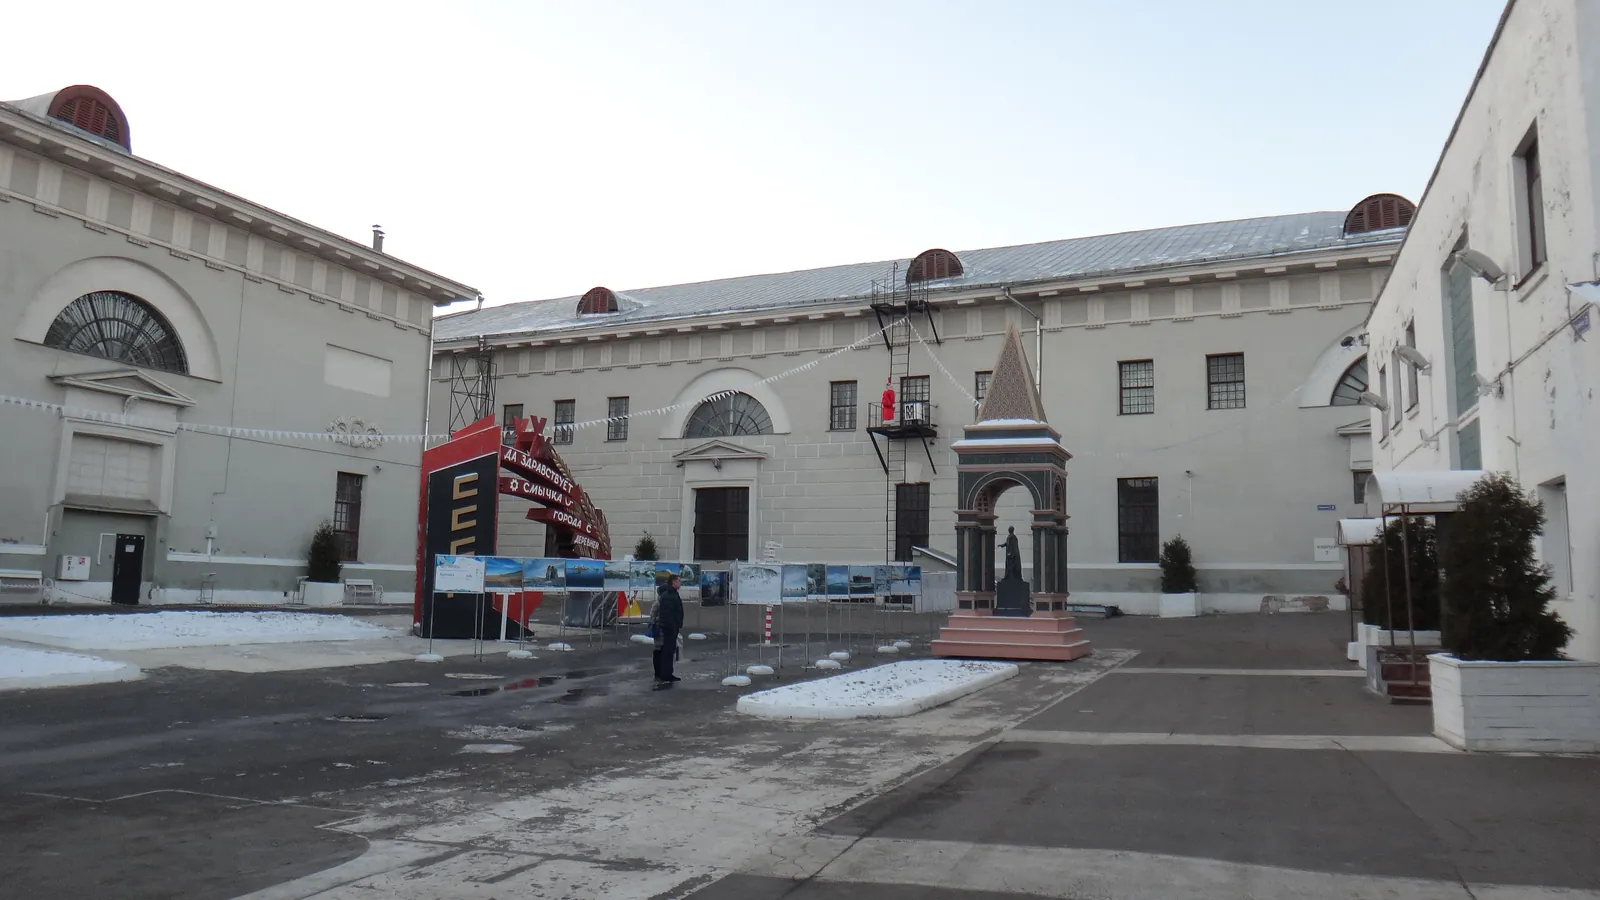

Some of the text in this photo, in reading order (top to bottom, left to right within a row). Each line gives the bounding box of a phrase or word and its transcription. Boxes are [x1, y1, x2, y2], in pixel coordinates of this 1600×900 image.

[504, 449, 574, 494] ДА ЗДРАВСТВУЕТ
[523, 482, 563, 503] СМЫЧКА
[447, 472, 479, 598] ССС
[553, 510, 592, 533] ГОРОДА С
